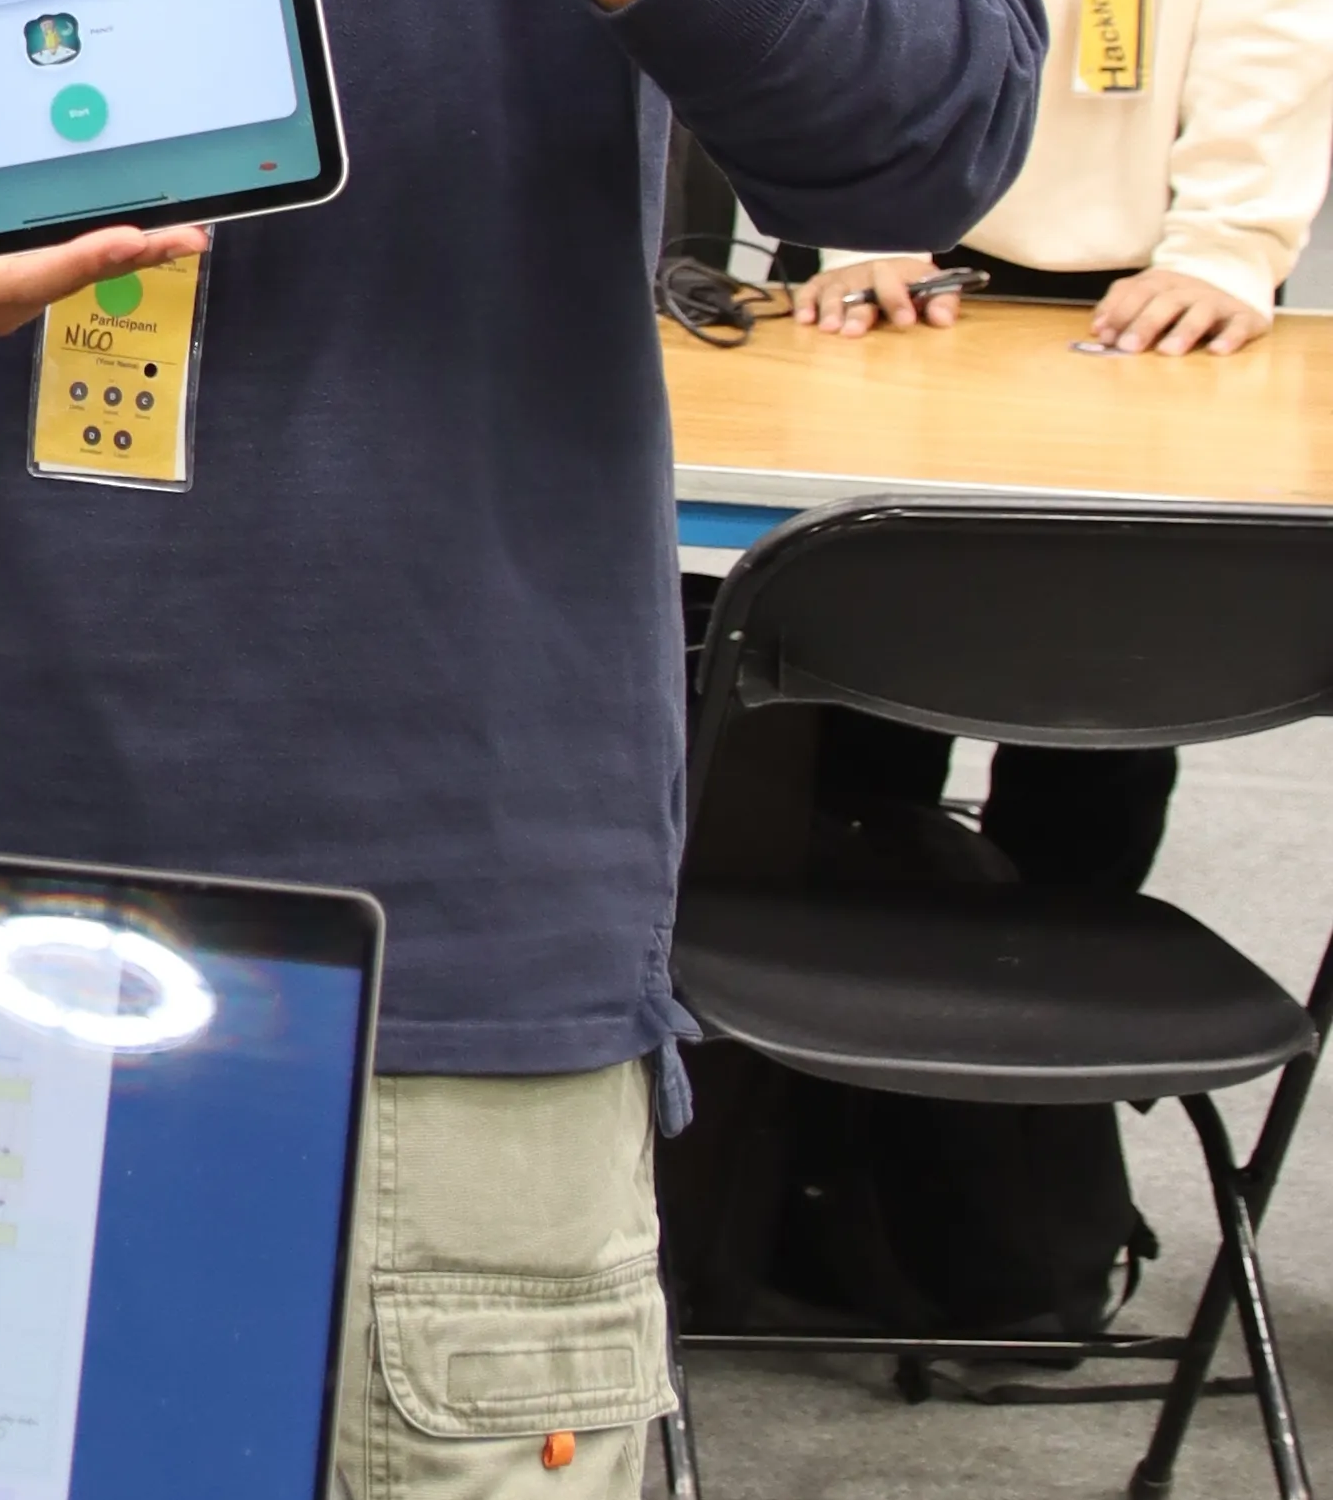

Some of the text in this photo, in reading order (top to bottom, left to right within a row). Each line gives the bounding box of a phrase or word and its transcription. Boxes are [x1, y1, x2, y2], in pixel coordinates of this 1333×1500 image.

[68, 106, 91, 120] Start
[90, 312, 158, 334] Participant
[65, 323, 113, 352] NICO
[75, 387, 82, 396] A
[141, 395, 149, 405] C
[88, 431, 96, 440] D
